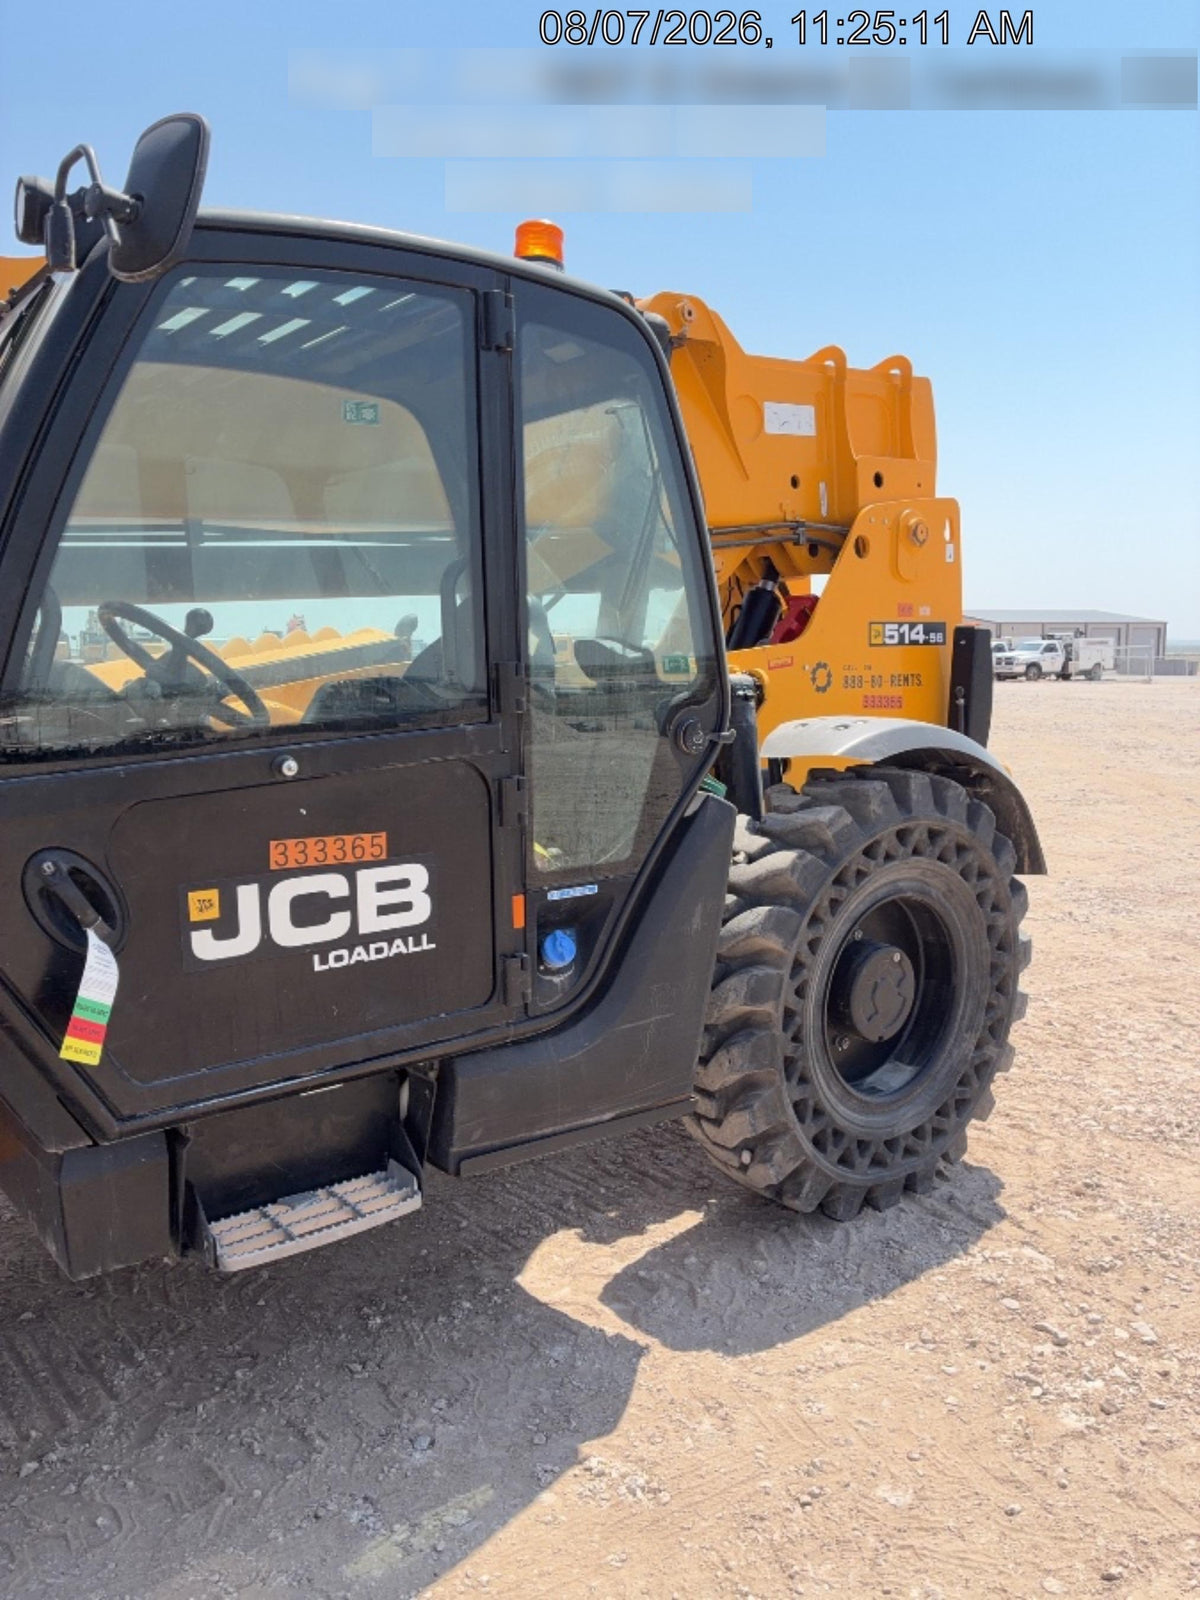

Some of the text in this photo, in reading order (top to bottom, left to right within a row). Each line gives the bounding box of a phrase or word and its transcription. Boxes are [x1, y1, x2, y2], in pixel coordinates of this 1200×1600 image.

[274, 835, 384, 867] 333365
[190, 863, 432, 961] JCB
[312, 933, 436, 972] LOADALL
